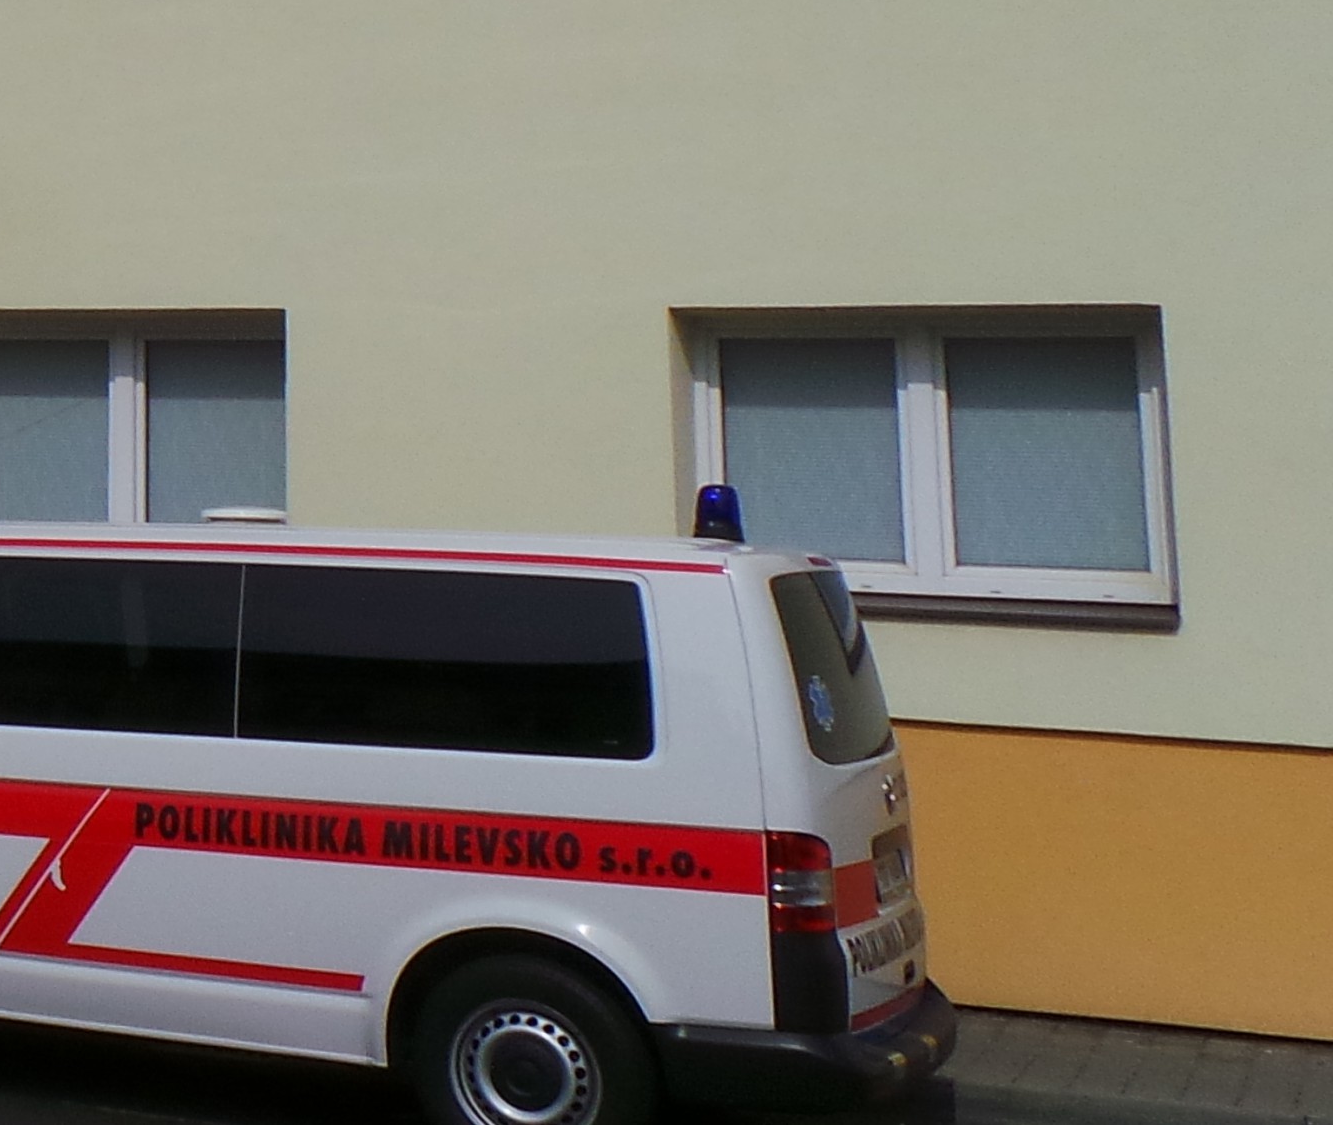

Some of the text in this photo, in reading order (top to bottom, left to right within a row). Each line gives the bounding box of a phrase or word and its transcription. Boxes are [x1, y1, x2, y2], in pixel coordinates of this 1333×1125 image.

[134, 802, 713, 880] POLIKLINIKA MILEVSKO s.r.o.
